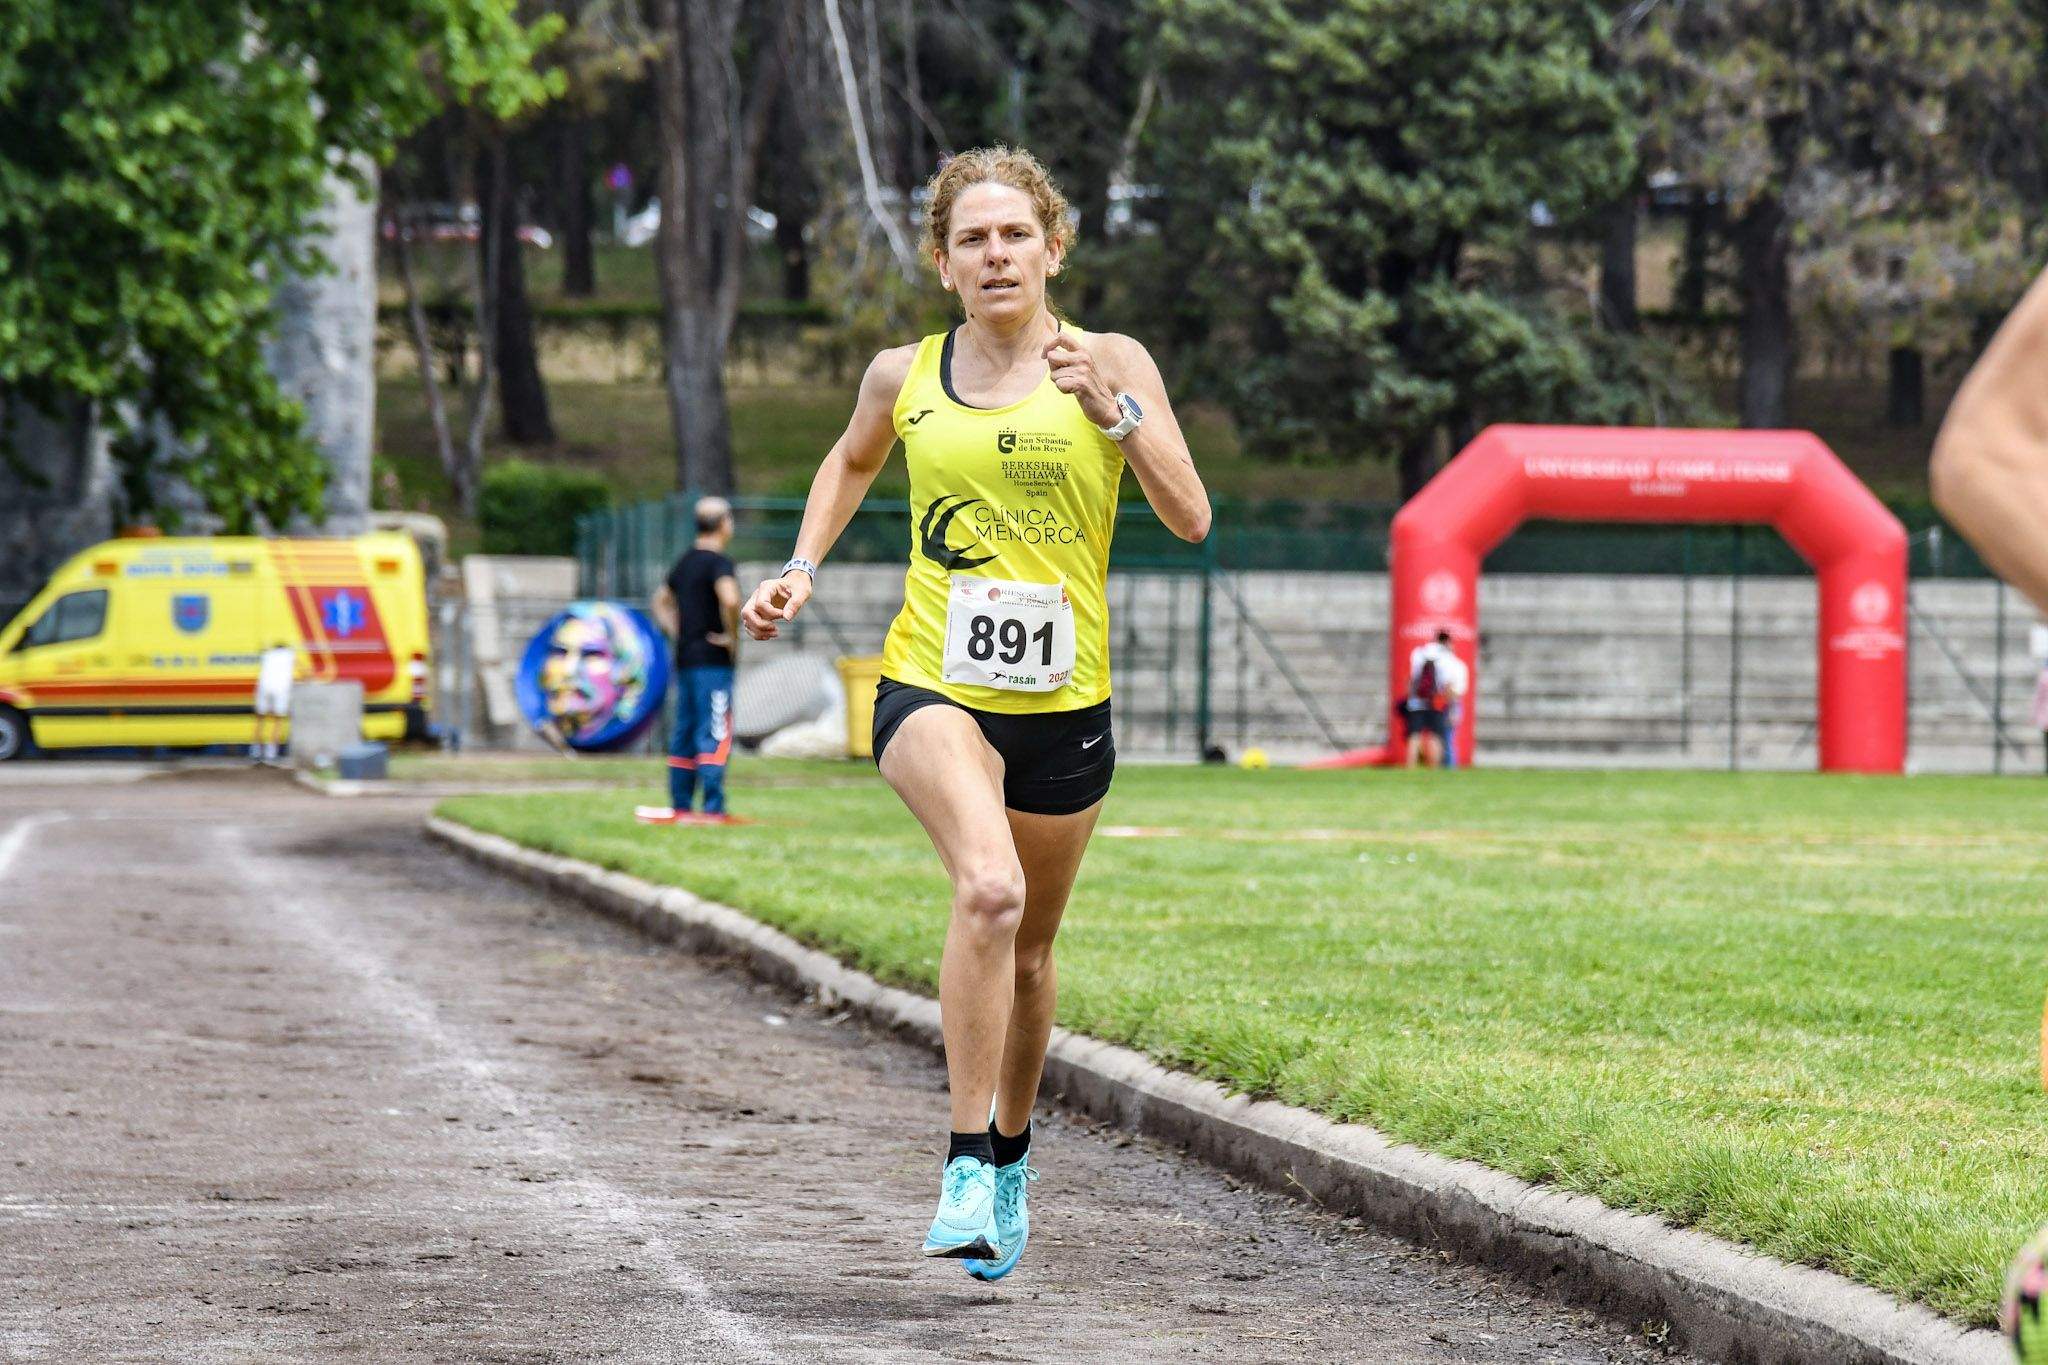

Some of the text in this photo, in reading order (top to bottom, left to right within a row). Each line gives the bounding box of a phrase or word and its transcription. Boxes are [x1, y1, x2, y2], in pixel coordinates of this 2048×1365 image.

[1035, 437, 1073, 446] Sebastián
[1018, 444, 1066, 454] de los Reyes
[1001, 461, 1070, 471] BERKSHIRE
[1004, 470, 1068, 480] HATHAWAY
[1025, 489, 1048, 498] Spain
[974, 505, 1058, 525] CLÍNICA
[975, 523, 1086, 544] MENORCA
[967, 615, 1054, 665] 891
[1008, 674, 1037, 685] rasán
